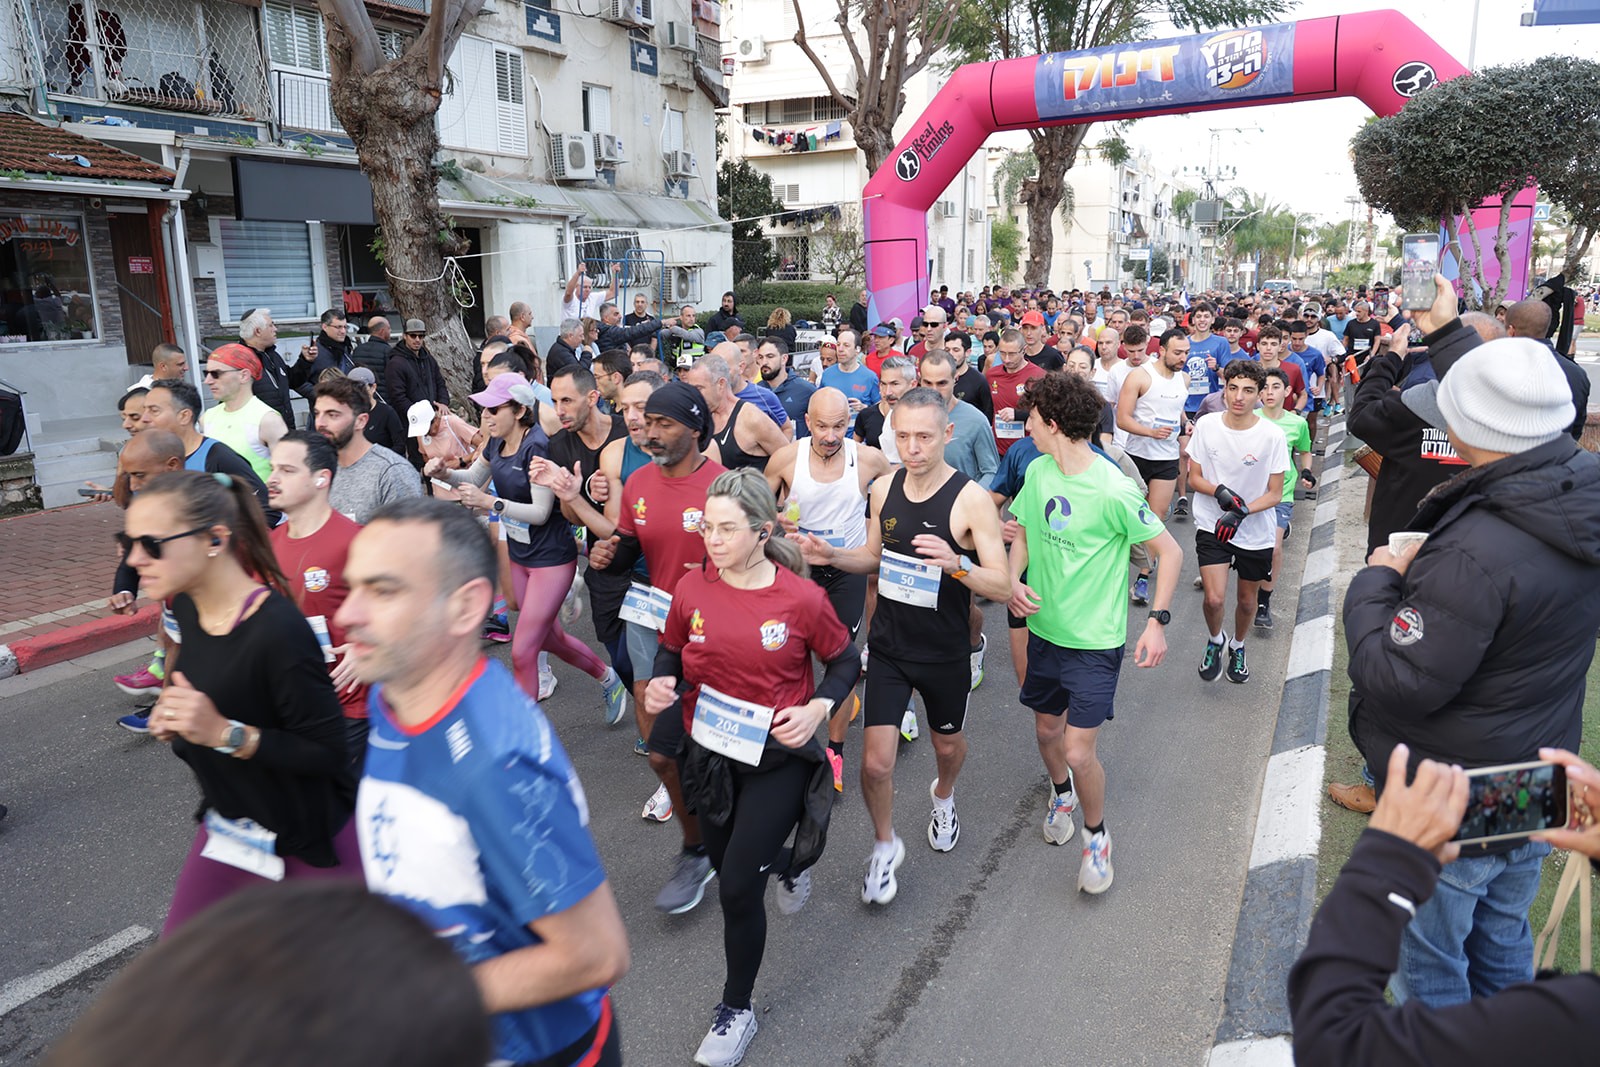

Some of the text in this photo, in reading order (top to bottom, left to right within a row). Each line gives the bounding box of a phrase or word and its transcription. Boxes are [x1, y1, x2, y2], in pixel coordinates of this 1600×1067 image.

[1200, 31, 1263, 68] מרוץ
[1217, 44, 1262, 66] אור יהודה
[911, 121, 935, 152] Real
[917, 119, 955, 161] Timing
[900, 574, 915, 586] 50
[635, 600, 648, 610] 90
[715, 717, 740, 735] 204
